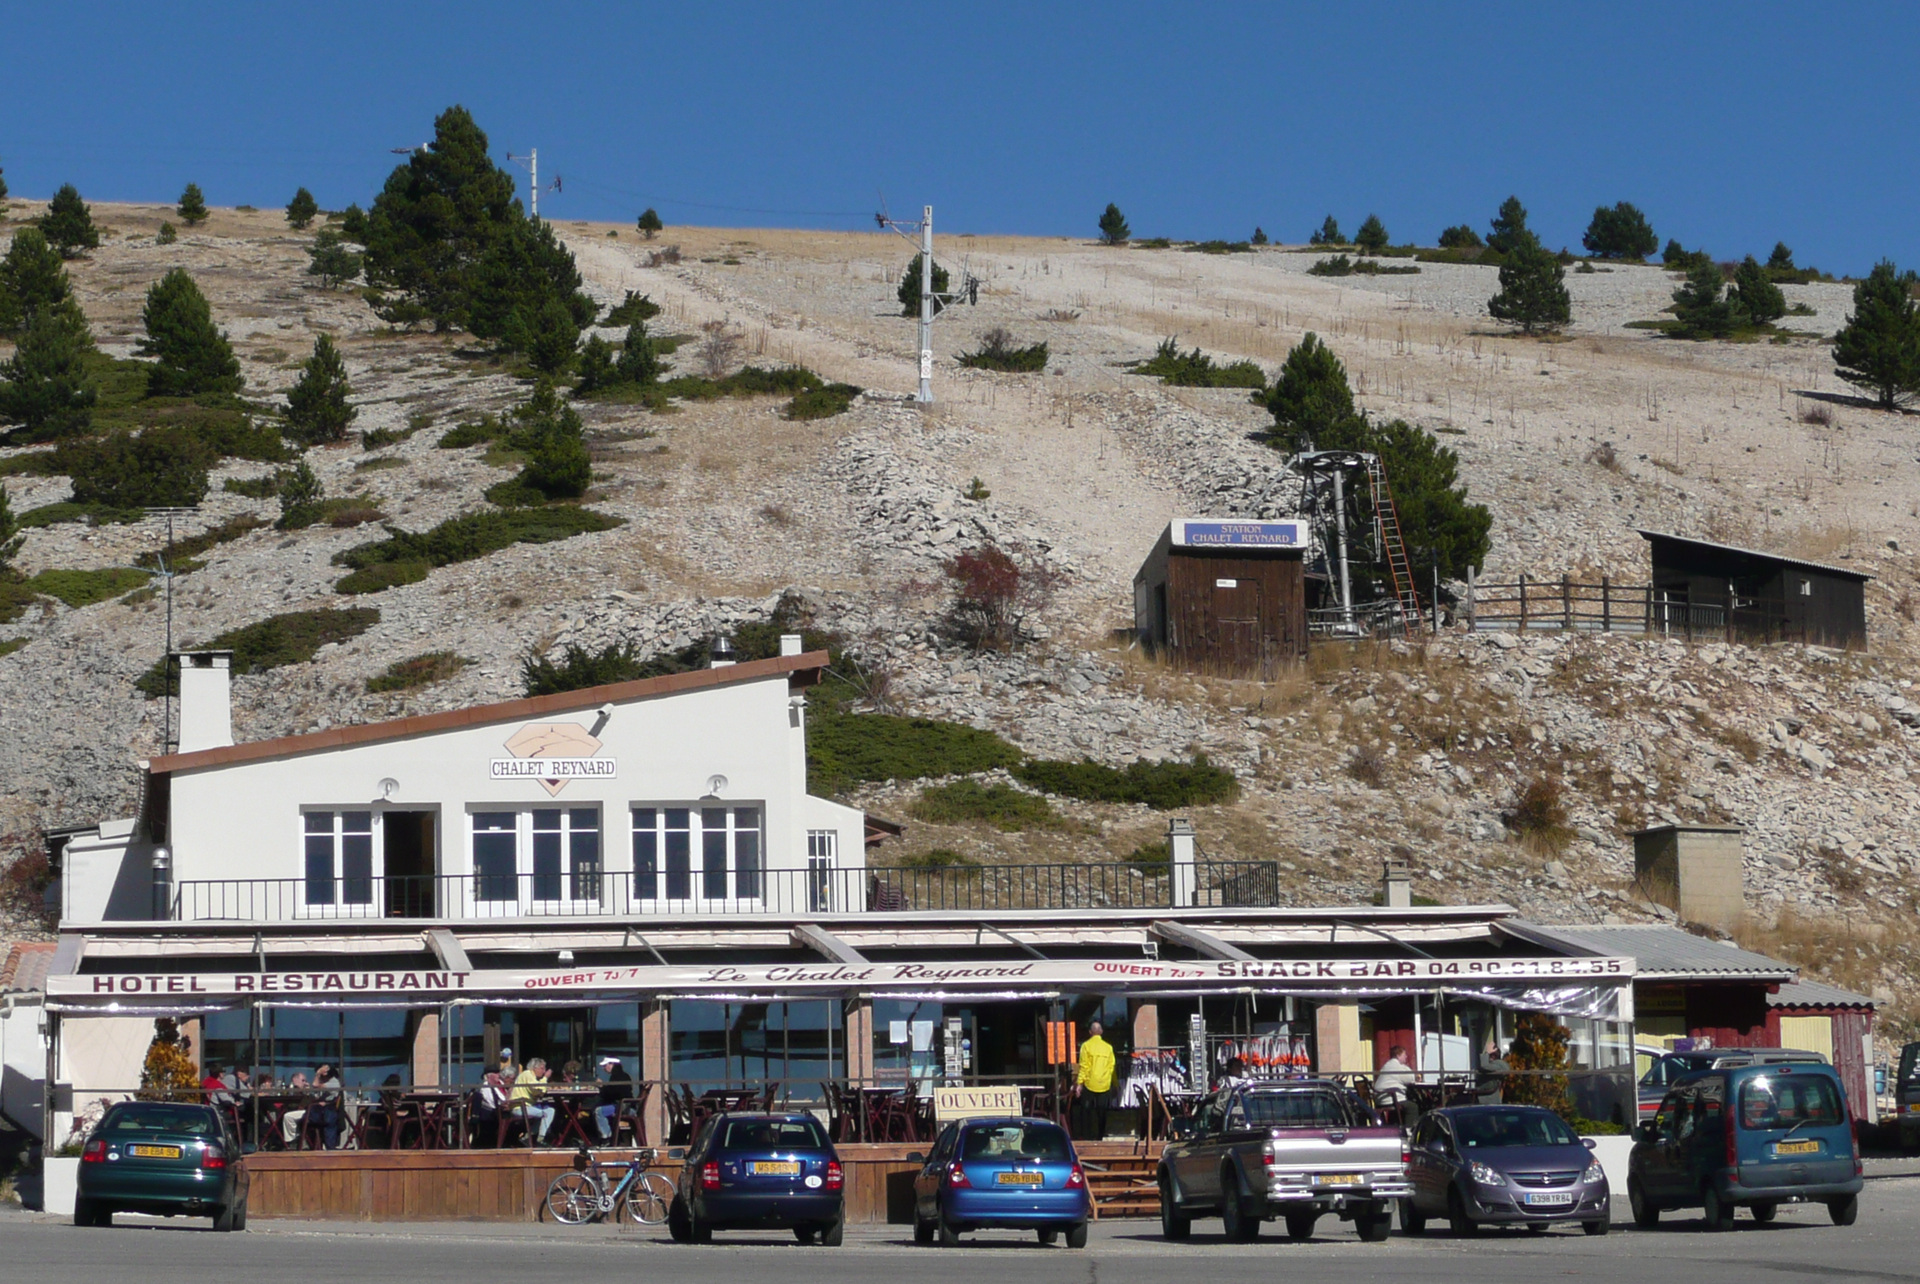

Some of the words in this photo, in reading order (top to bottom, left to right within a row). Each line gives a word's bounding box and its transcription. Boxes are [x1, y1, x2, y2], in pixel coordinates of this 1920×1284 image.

[1221, 525, 1262, 534] STATION
[1192, 534, 1232, 542] CHALET
[1241, 534, 1290, 543] REYNARD
[492, 761, 544, 776] CHALET
[552, 760, 615, 775] REYNARD
[698, 967, 748, 982] Le
[765, 966, 876, 981] Chalet
[893, 963, 1034, 984] Reynard
[1094, 962, 1163, 977] OUVERT
[1217, 962, 1336, 977] SNACK
[1350, 961, 1417, 976] BAR
[93, 976, 206, 993] HOTEL
[234, 972, 470, 992] RESTAURANT
[524, 972, 596, 989] OUVERT
[603, 968, 639, 981] 7J/7
[941, 1092, 1018, 1109] OUVERT
[1531, 1194, 1551, 1203] 6398
[1561, 1194, 1570, 1202] 84
